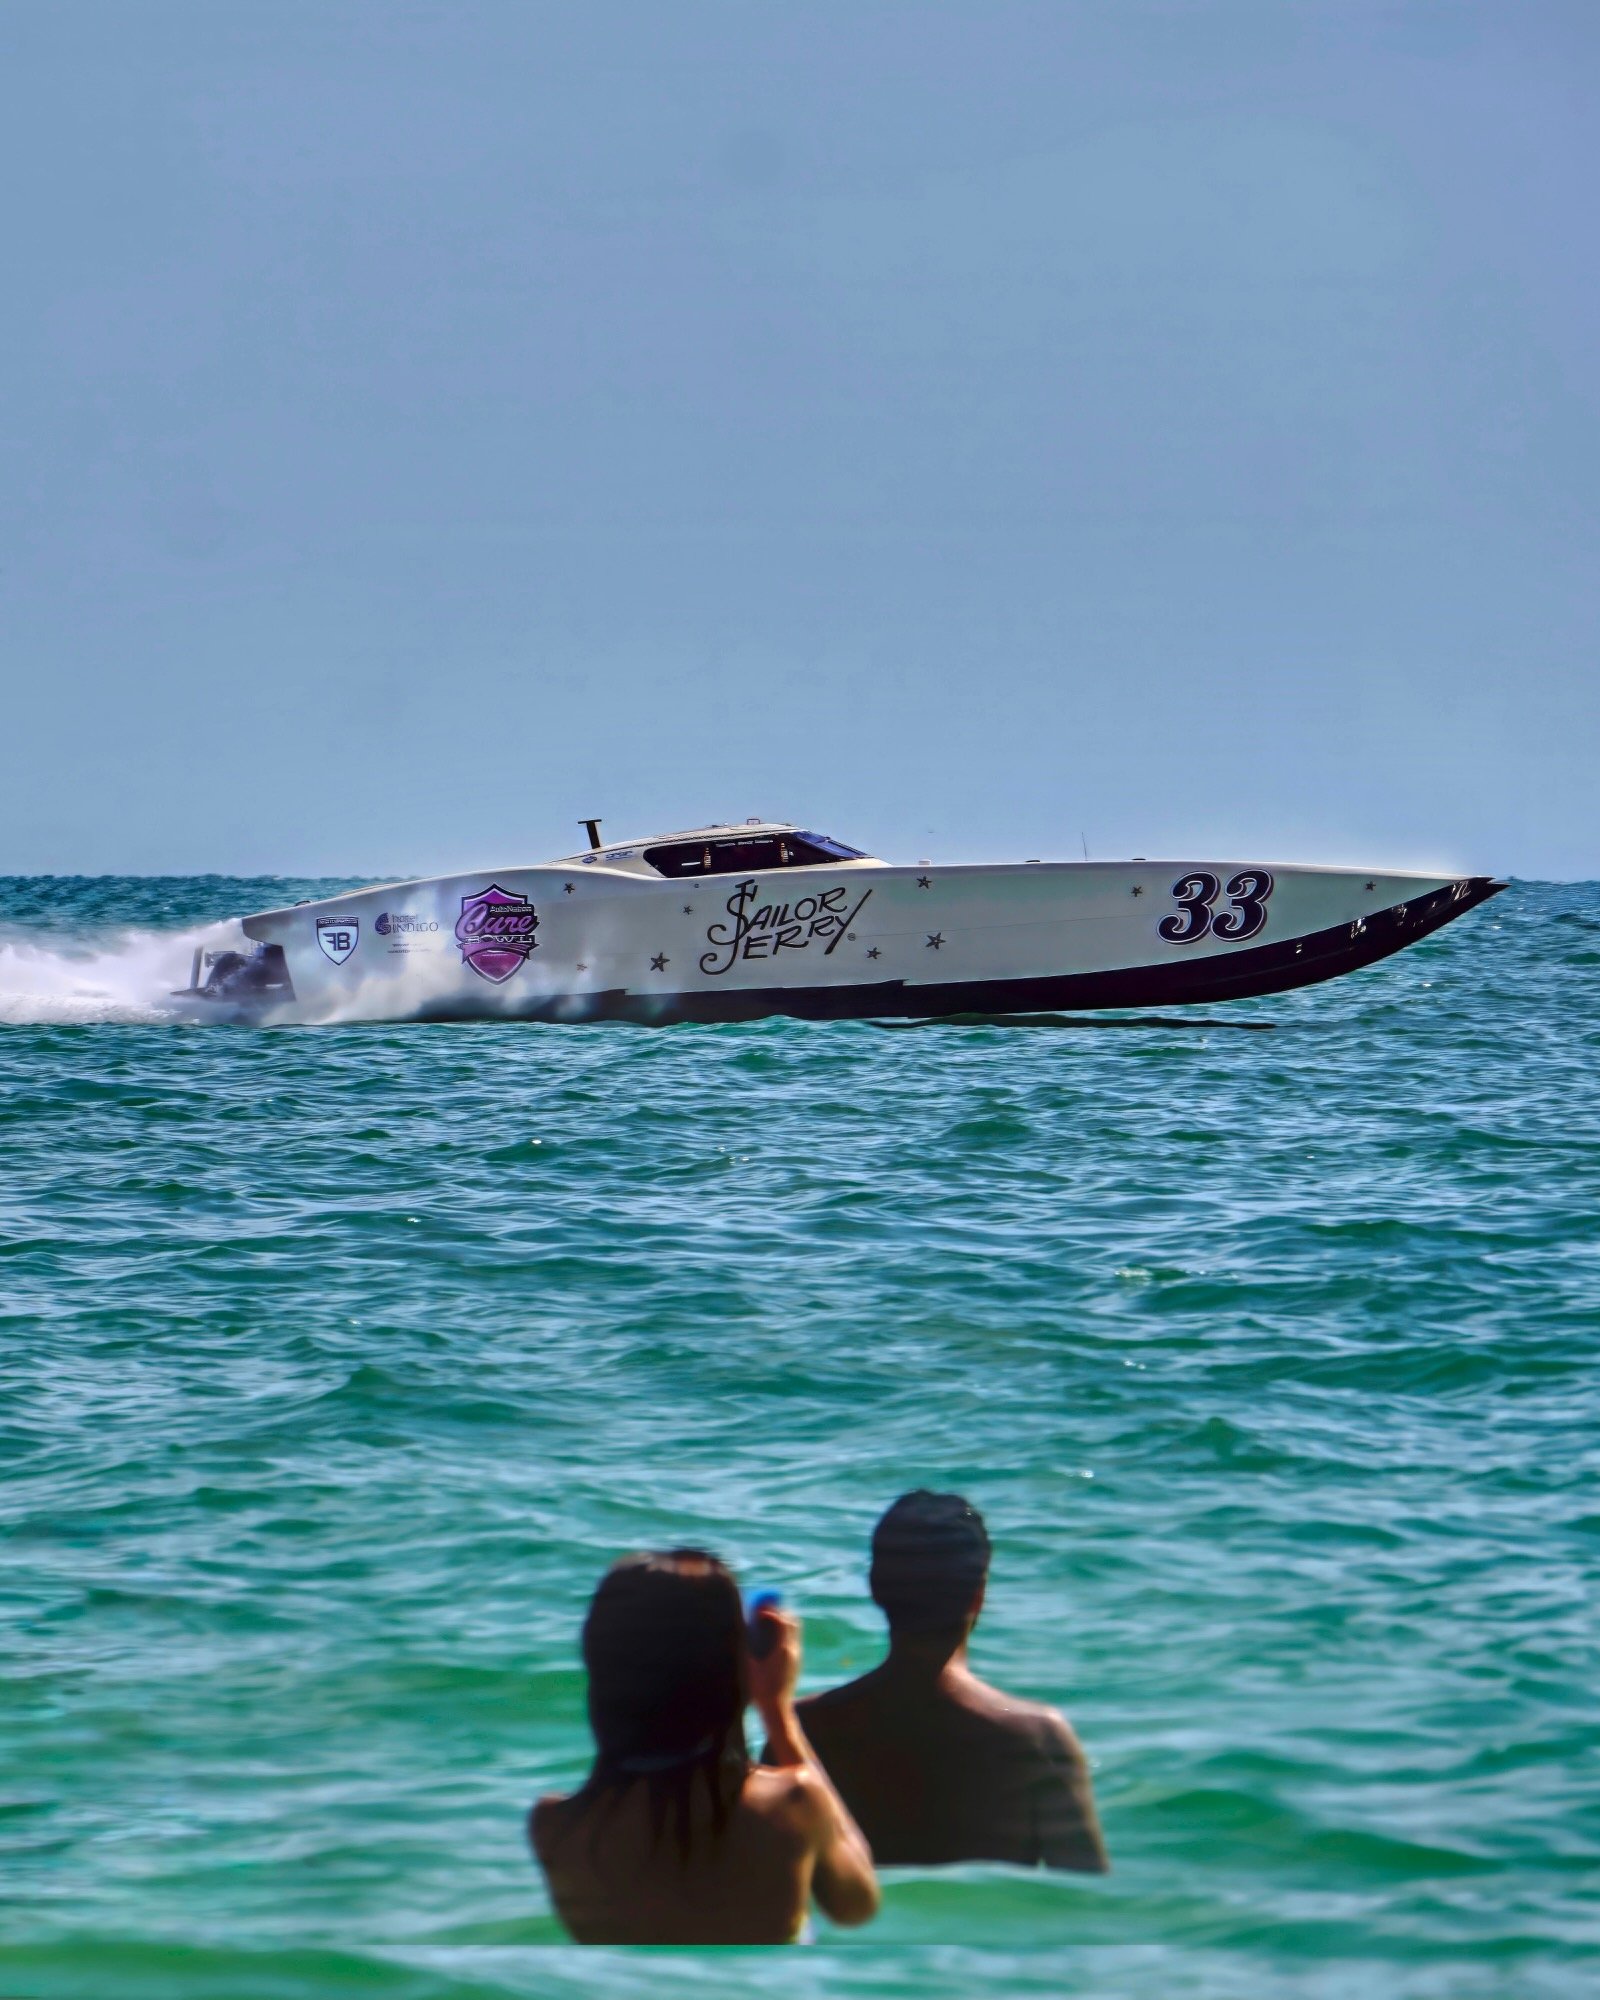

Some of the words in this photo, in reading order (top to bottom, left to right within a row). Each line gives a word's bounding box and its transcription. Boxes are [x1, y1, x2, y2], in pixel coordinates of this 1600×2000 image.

[456, 903, 536, 941] Cure
[700, 879, 872, 975] JERRY
[707, 887, 848, 945] SAILOR
[1156, 869, 1275, 945] 33
